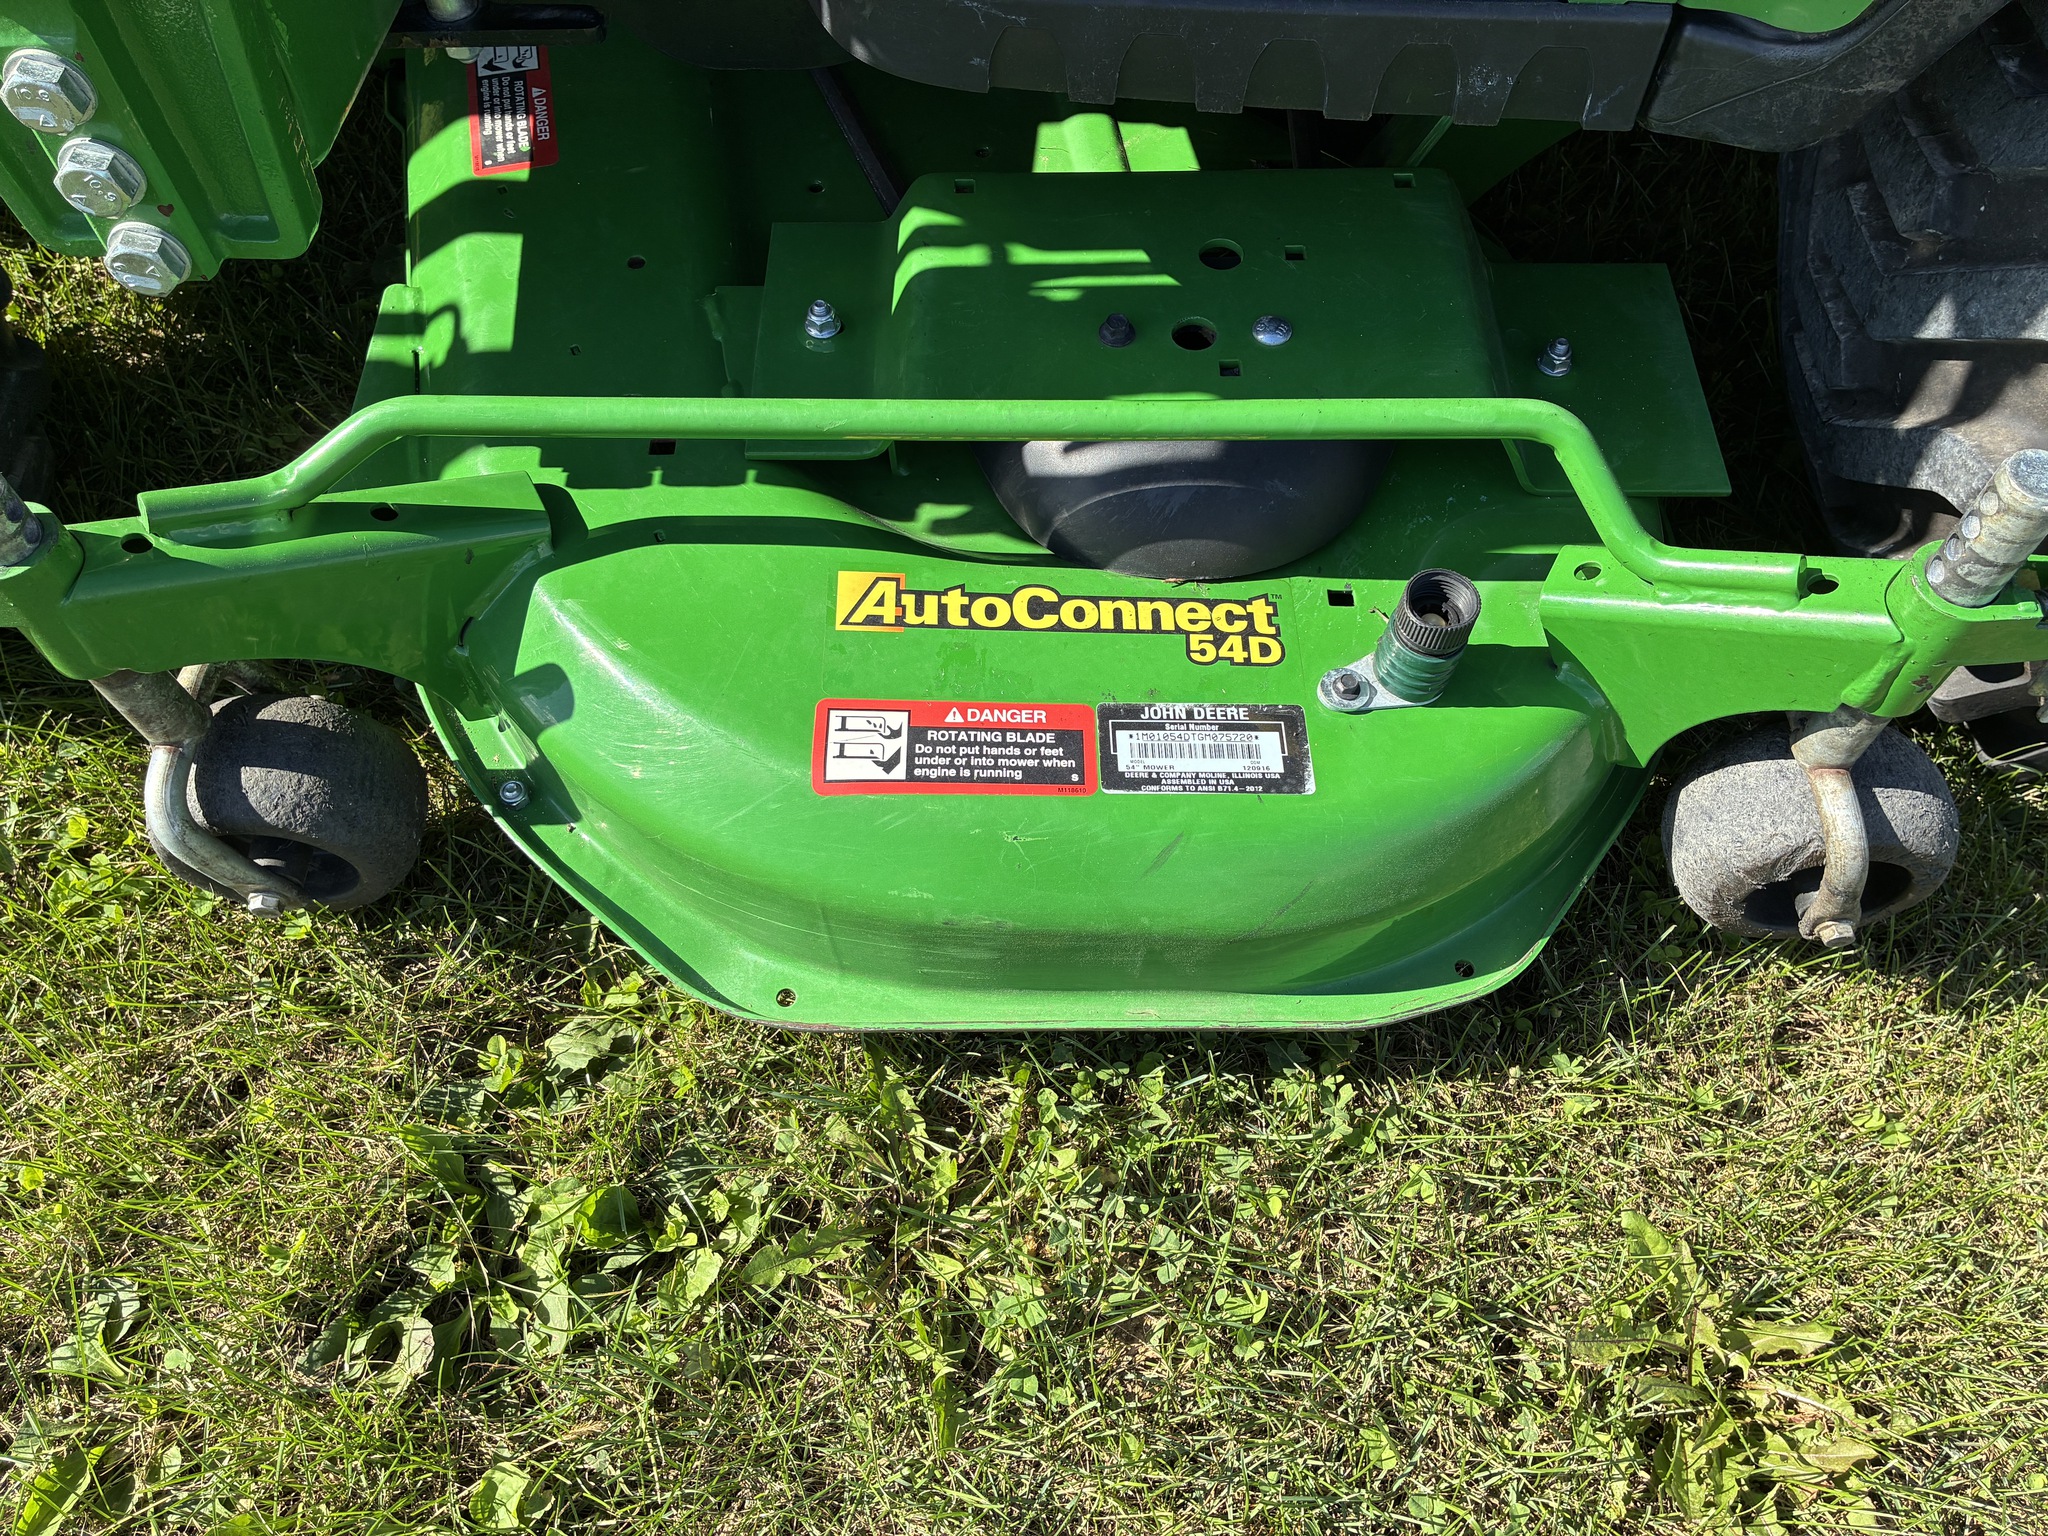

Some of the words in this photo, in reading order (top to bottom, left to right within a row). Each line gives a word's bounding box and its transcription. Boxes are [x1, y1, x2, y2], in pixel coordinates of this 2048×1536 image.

[492, 78, 501, 96] under
[502, 76, 510, 86] Do
[481, 79, 492, 101] engine
[503, 87, 511, 98] not
[483, 101, 492, 109] is
[494, 97, 500, 105] or
[502, 98, 512, 110] put
[514, 80, 526, 119] ROTATING
[494, 105, 502, 119] into
[534, 97, 550, 141] DANGER
[483, 109, 494, 136] running
[504, 110, 514, 131] hands
[494, 119, 504, 142] mower
[506, 132, 514, 140] or
[516, 120, 529, 148] BLADE
[496, 142, 506, 163] when
[507, 139, 516, 154] feet
[847, 580, 1276, 635] AutoConnect
[1189, 634, 1282, 664] 54D
[967, 708, 1047, 724] DANGER
[1140, 706, 1187, 720] JOHN
[1193, 706, 1250, 720] DEERE
[1164, 723, 1187, 731] Serial
[1188, 723, 1220, 732] Number
[927, 730, 1002, 743] ROTATING
[1006, 732, 1056, 744] BLADE
[915, 743, 933, 754] Do
[936, 744, 957, 754] not
[960, 745, 980, 757] put
[983, 745, 1021, 756] hands
[1024, 747, 1038, 756] or
[1040, 746, 1064, 757] feet
[914, 755, 952, 765] under
[954, 757, 968, 766] or
[970, 756, 995, 766] into
[998, 758, 1040, 767] mower
[1043, 757, 1076, 768] when
[913, 766, 957, 779] engine
[960, 766, 971, 777] is
[974, 768, 1023, 780] running
